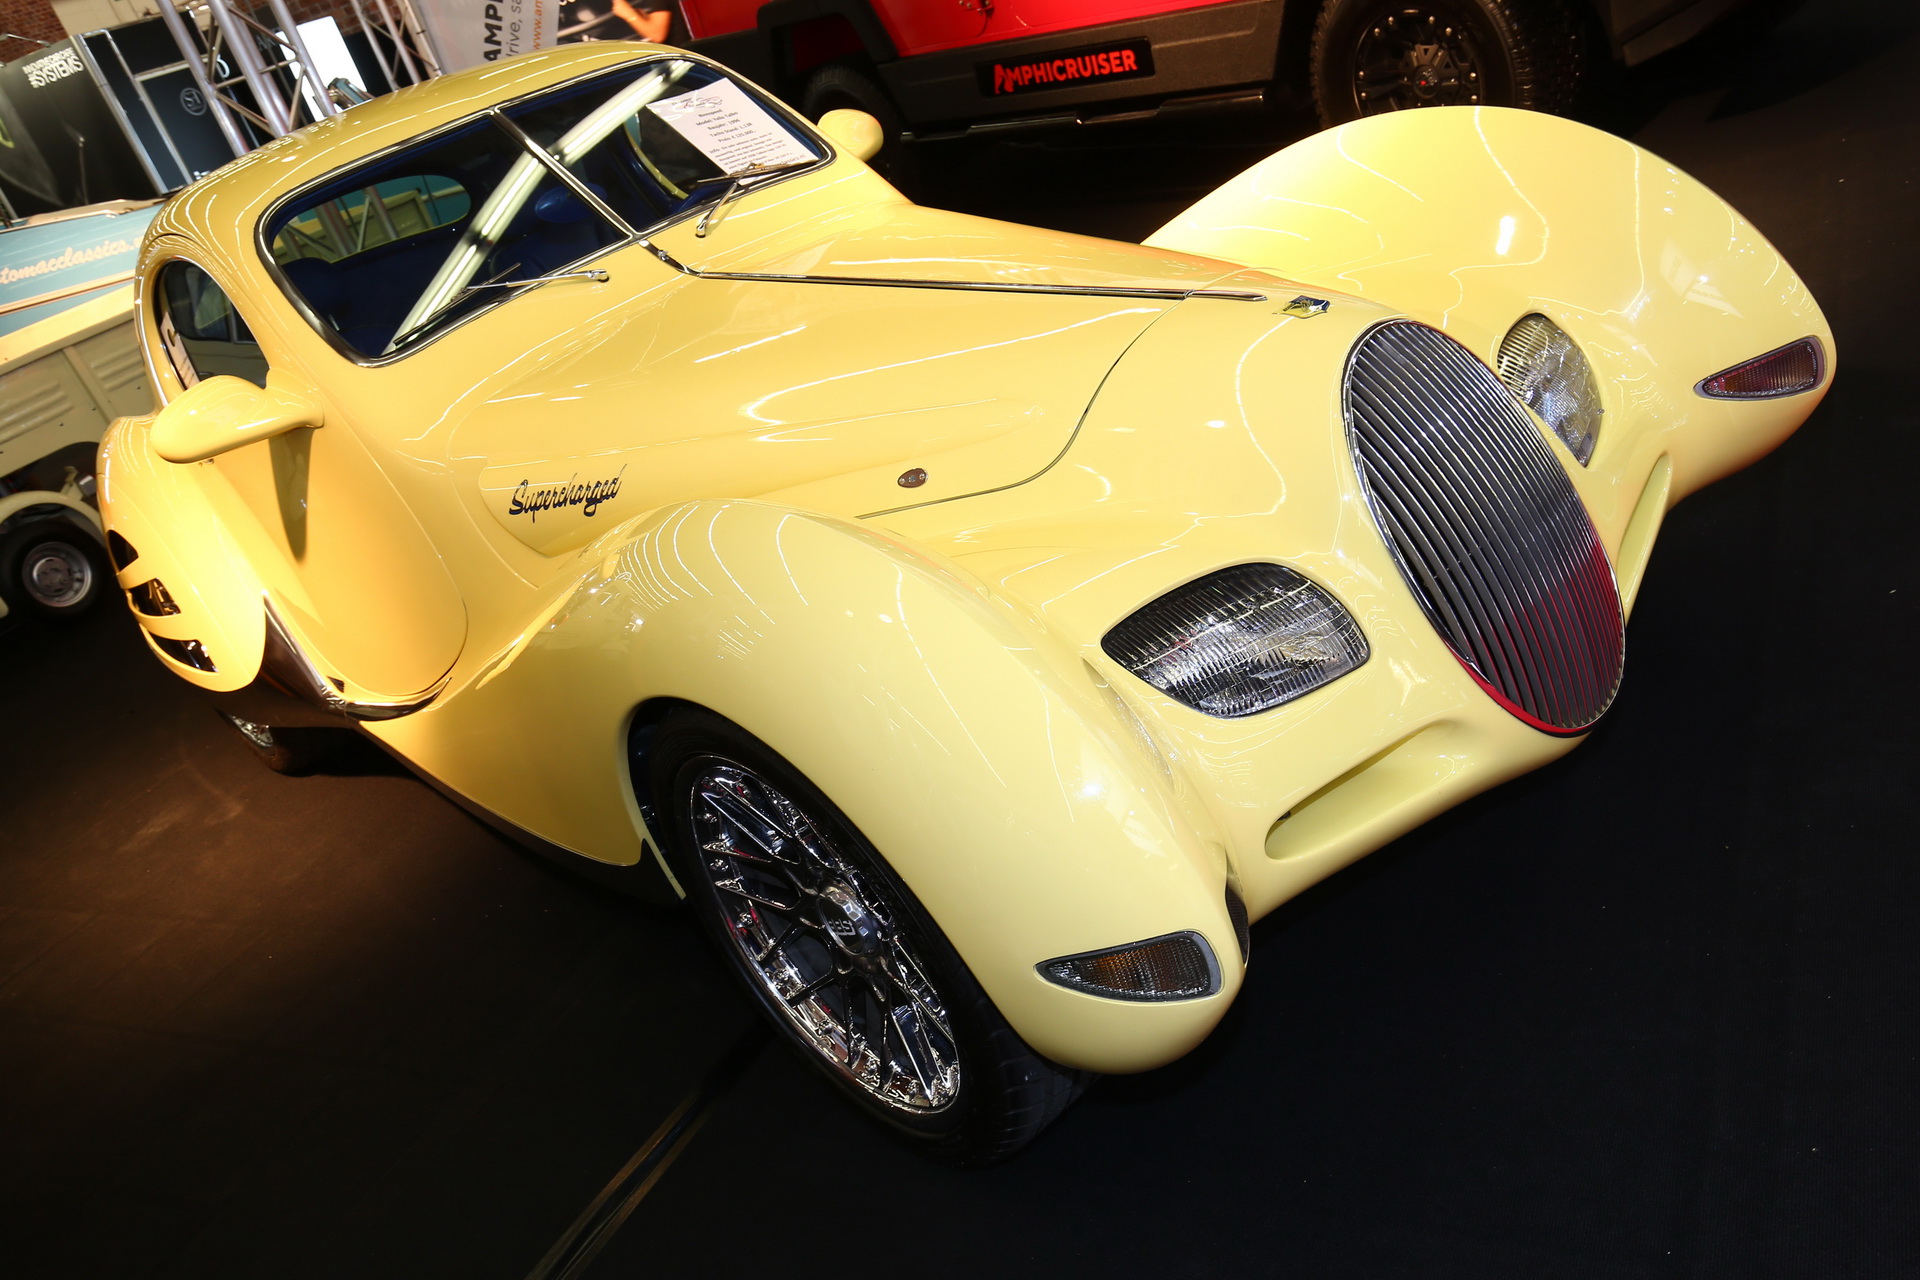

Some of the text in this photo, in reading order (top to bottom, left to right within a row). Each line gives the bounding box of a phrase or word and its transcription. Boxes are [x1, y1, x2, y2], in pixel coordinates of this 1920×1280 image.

[483, 0, 503, 61] AMP
[993, 49, 1138, 94] AMPHICRUISER
[508, 463, 628, 523] Supercharged
[827, 918, 855, 935] BBS
